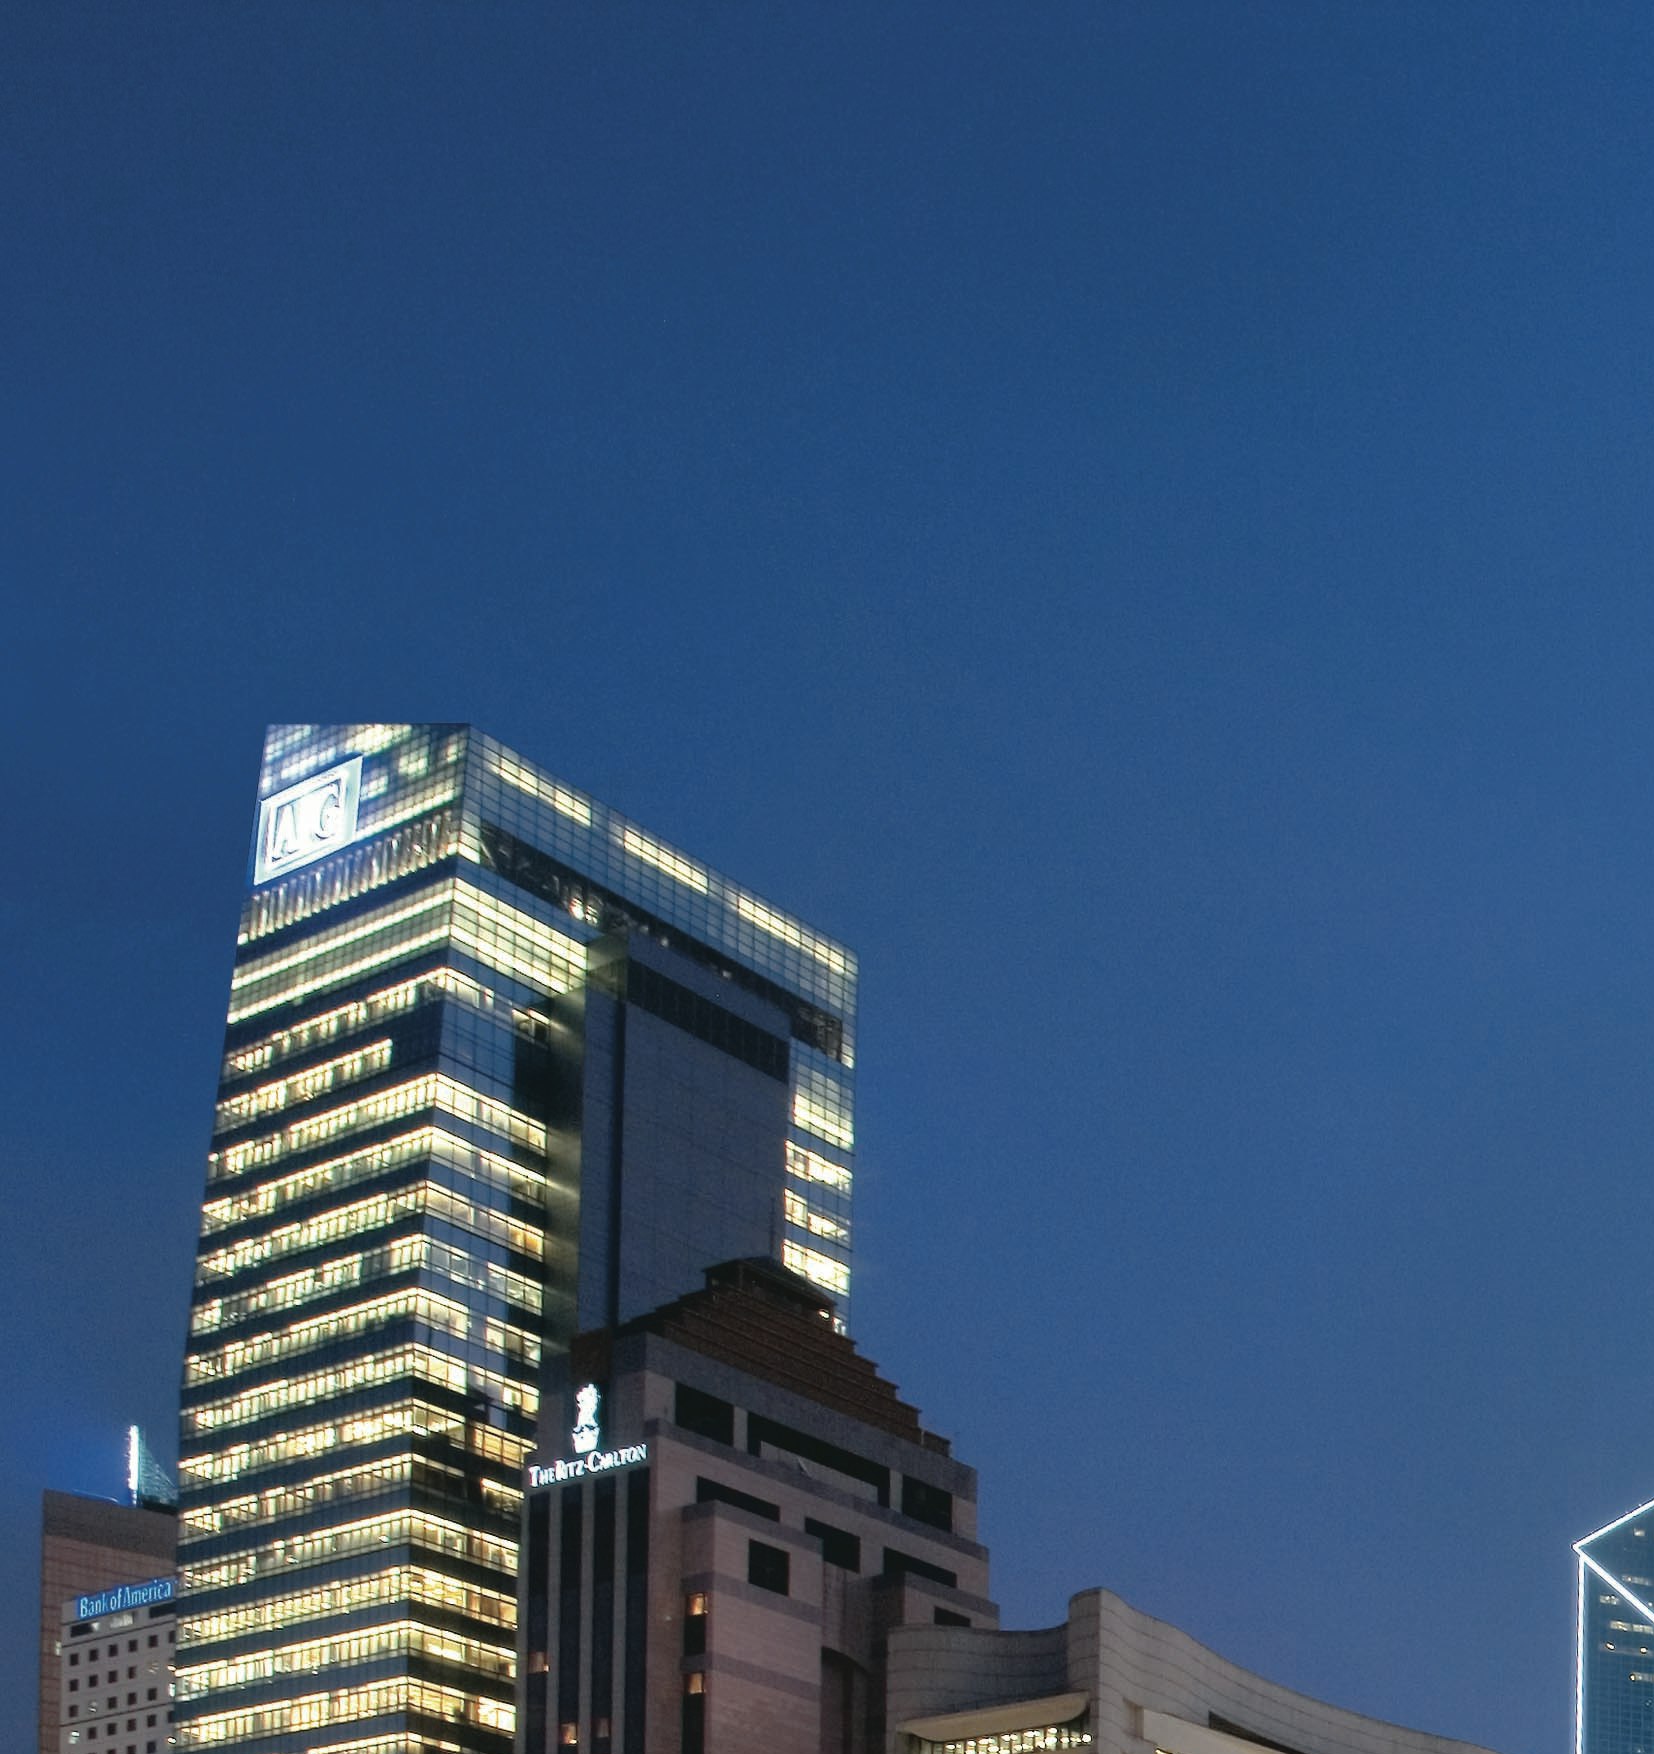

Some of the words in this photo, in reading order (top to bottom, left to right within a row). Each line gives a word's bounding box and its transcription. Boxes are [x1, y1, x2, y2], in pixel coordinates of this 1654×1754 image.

[271, 778, 341, 861] AG
[80, 1593, 108, 1617] Bank
[110, 1588, 122, 1610] of
[122, 1579, 171, 1607] America
